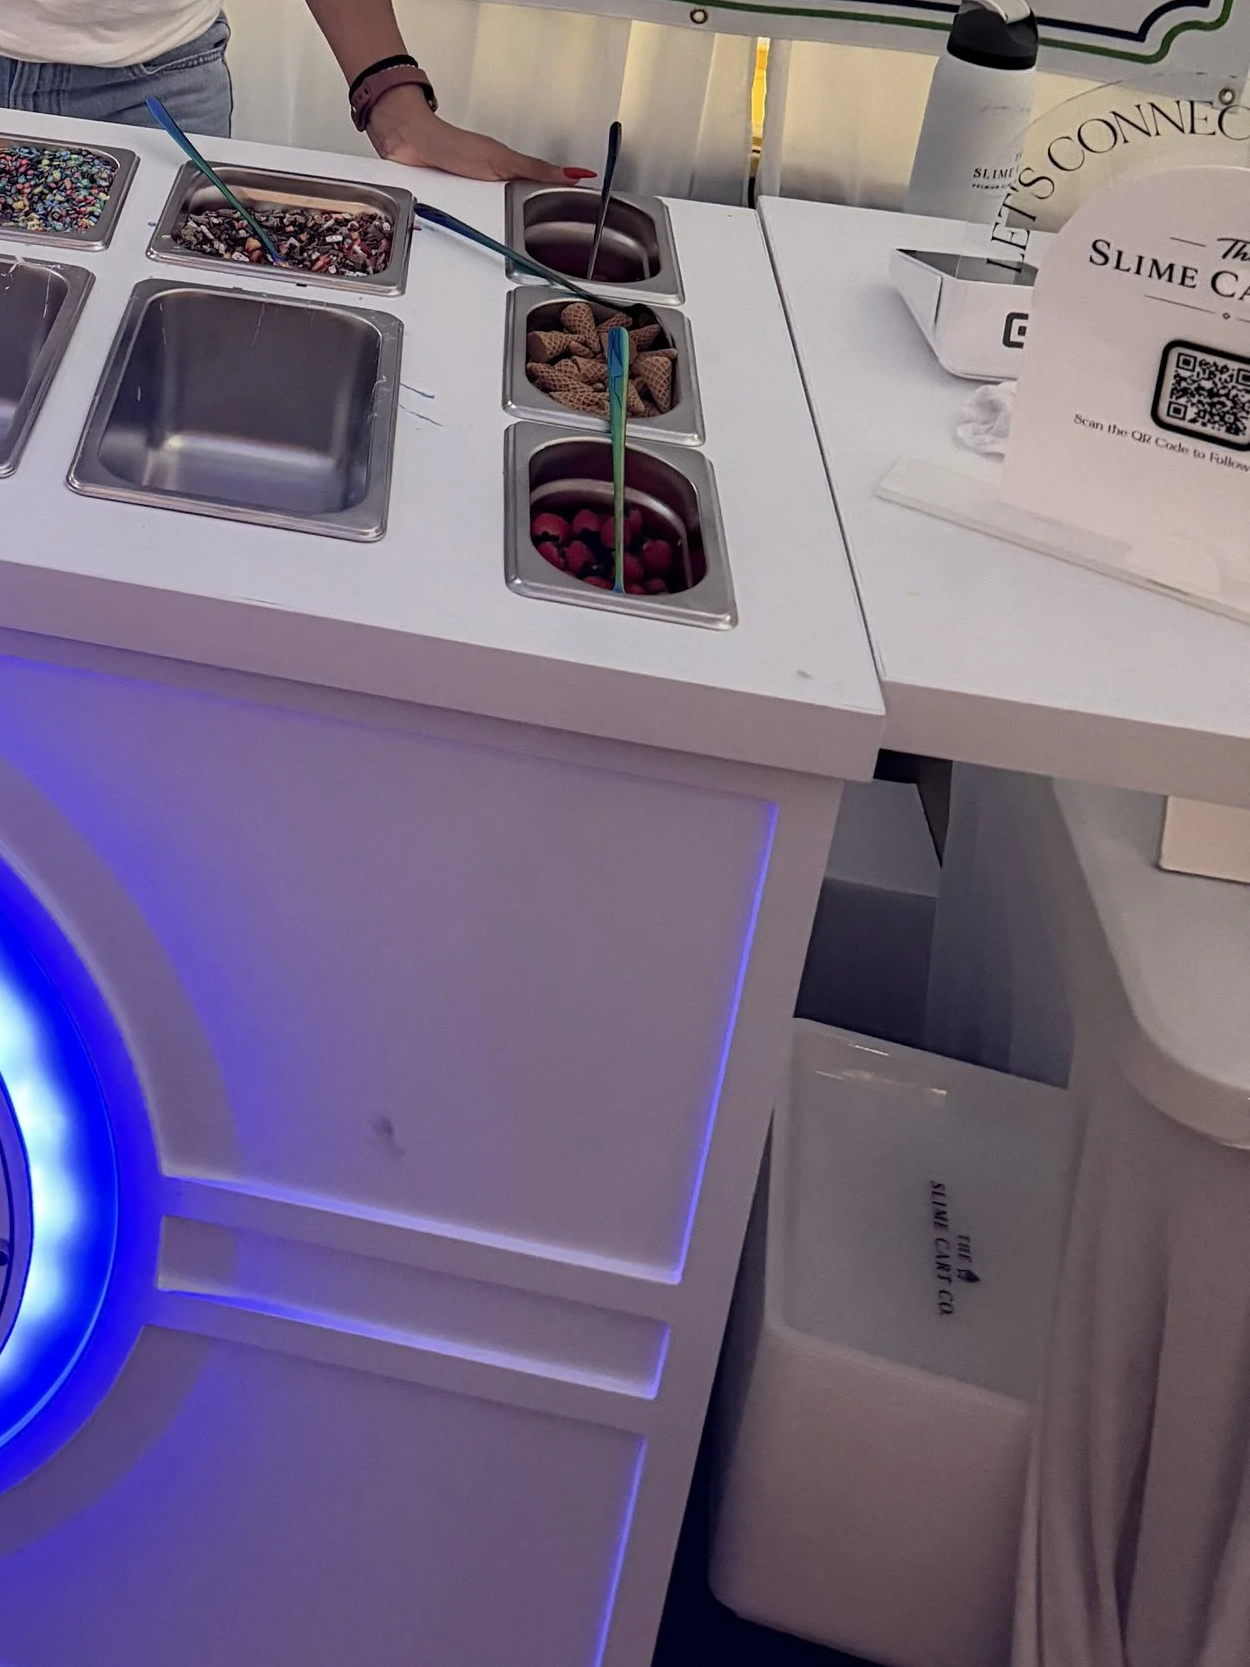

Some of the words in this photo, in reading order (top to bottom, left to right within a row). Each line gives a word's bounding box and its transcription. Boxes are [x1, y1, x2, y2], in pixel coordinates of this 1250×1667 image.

[986, 167, 1055, 273] LET'S
[1089, 238, 1199, 289] SLIME
[1073, 413, 1105, 431] Scan
[1107, 423, 1128, 437] the
[1131, 429, 1152, 444] QR
[1154, 437, 1190, 454] Code
[1193, 446, 1206, 459] to
